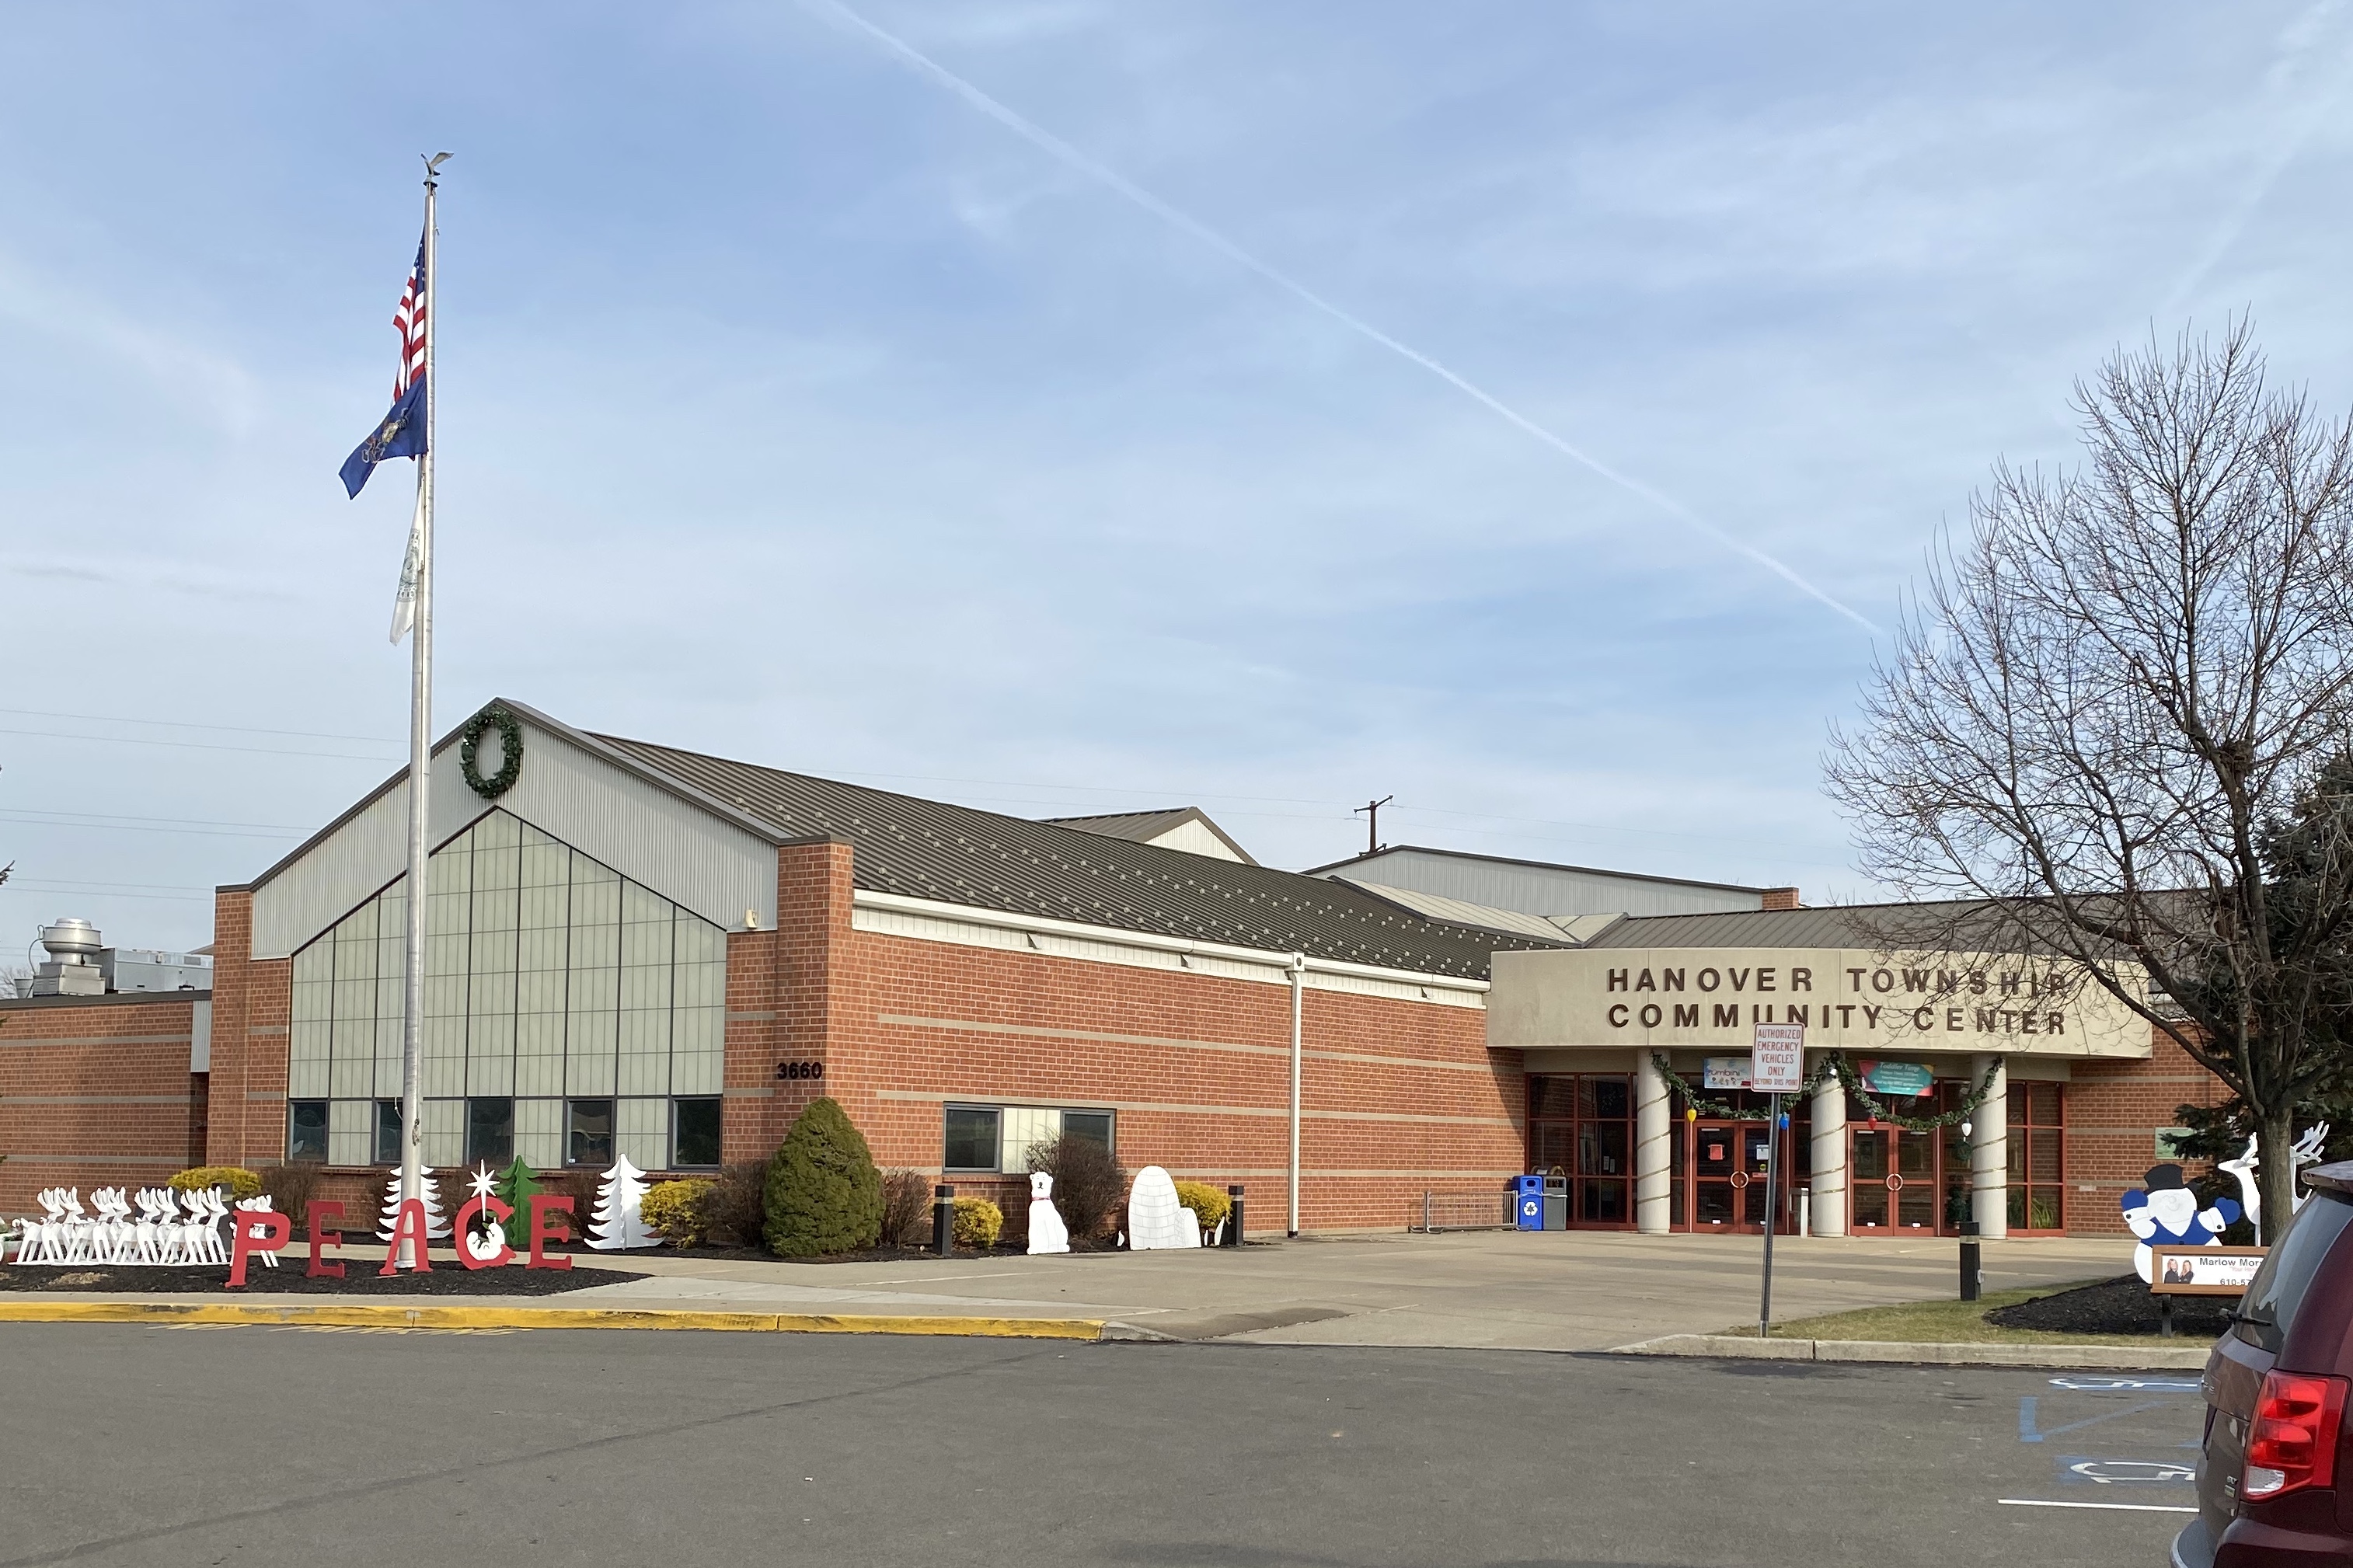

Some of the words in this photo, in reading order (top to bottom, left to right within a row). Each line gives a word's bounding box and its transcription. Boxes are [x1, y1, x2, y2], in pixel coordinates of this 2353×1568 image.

[1608, 967, 1812, 992] HANOVER
[1847, 967, 2066, 998] TOWNSHIP
[1609, 1003, 1883, 1028] COMMUNITY
[1914, 1006, 2065, 1035] CENTER
[1757, 1029, 1801, 1039] AUTHORIZED
[1757, 1041, 1799, 1051] EMERGENCY
[1761, 1053, 1794, 1064] VEHICLES
[777, 1061, 822, 1079] 3660
[1767, 1066, 1786, 1076] ONLY
[225, 1195, 574, 1288] PEACE
[2199, 1257, 2236, 1267] Marlow
